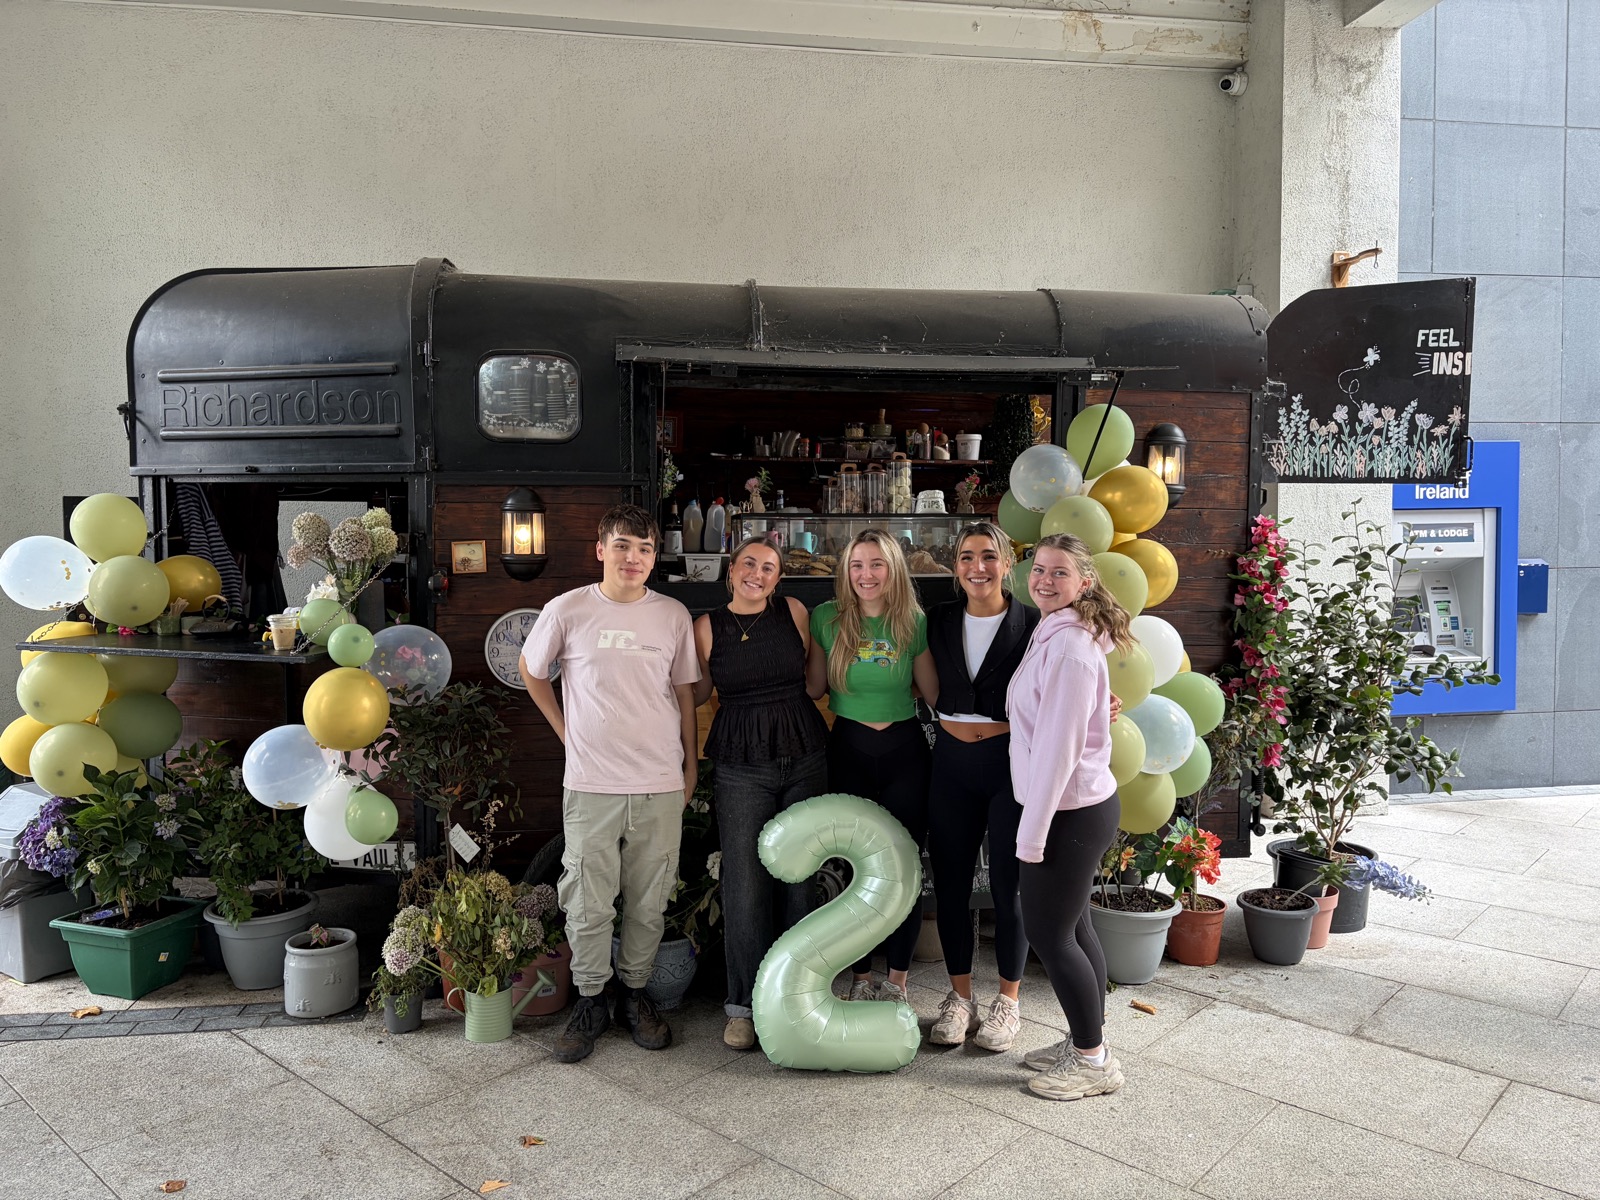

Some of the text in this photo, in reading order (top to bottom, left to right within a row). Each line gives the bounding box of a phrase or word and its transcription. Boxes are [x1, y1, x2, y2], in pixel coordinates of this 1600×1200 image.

[1417, 328, 1460, 348] FEEL
[160, 380, 402, 427] Richardson
[1415, 484, 1469, 500] Ireland
[1409, 529, 1469, 538] ATM & LODGE
[505, 620, 512, 631] 11
[520, 615, 530, 626] 12
[495, 631, 506, 643] 10
[491, 647, 500, 658] 9
[498, 662, 506, 673] 8
[512, 672, 519, 682] 7
